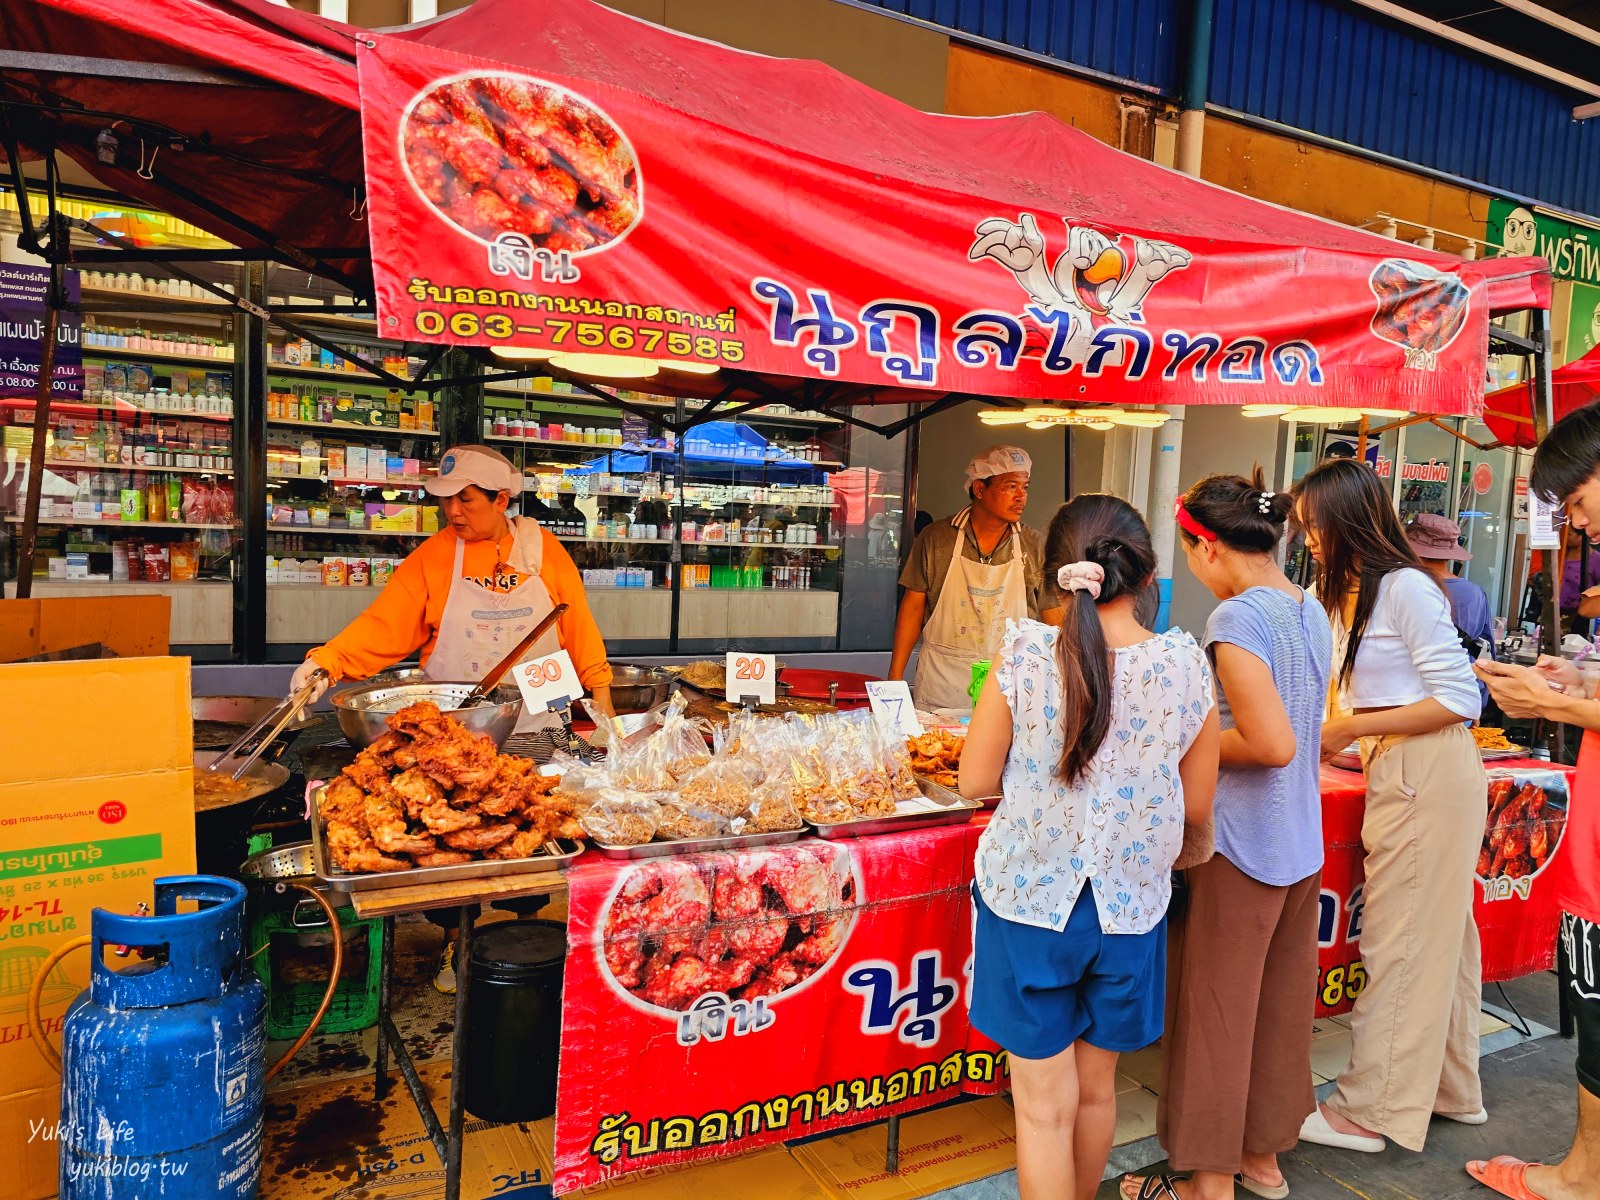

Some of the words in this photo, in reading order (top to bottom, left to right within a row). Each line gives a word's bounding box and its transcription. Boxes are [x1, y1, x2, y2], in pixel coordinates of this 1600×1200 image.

[489, 234, 580, 282] เงิน
[407, 279, 736, 334] รับออกงานนอกสถานที่
[414, 311, 744, 362] 063-7567585
[752, 278, 1324, 386] นุกูลไก่ทอด
[525, 659, 562, 688] 30
[736, 657, 765, 680] 20
[102, 810, 123, 820] ISO
[1483, 876, 1532, 903] ทอง
[679, 994, 773, 1045] เงิน
